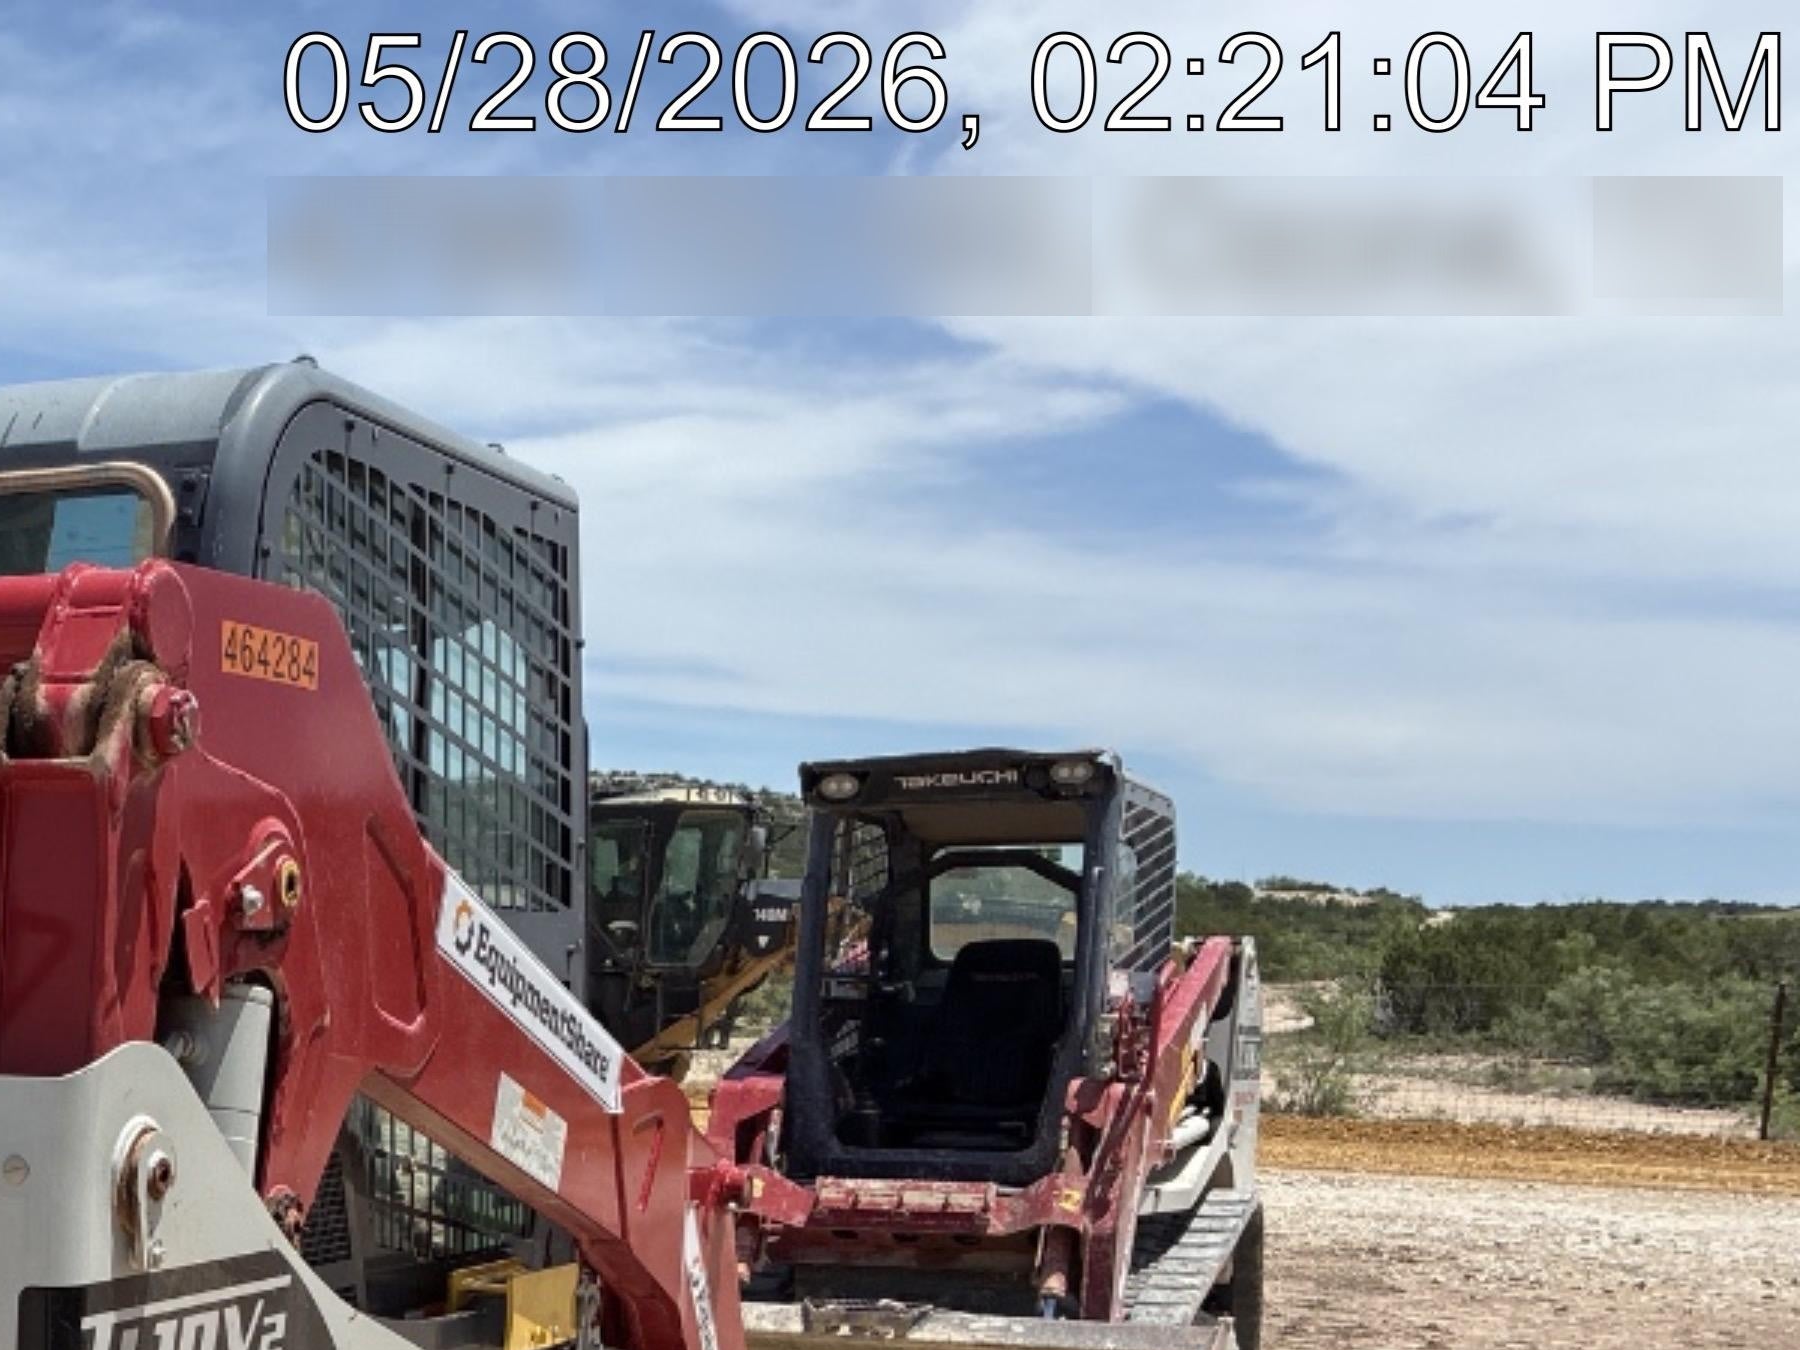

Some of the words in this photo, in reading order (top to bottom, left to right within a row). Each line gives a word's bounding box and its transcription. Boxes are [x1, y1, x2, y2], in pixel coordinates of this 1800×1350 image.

[224, 625, 316, 686] 464284
[893, 769, 1019, 790] TAKEUCHI
[473, 922, 612, 1083] EquipmentShare
